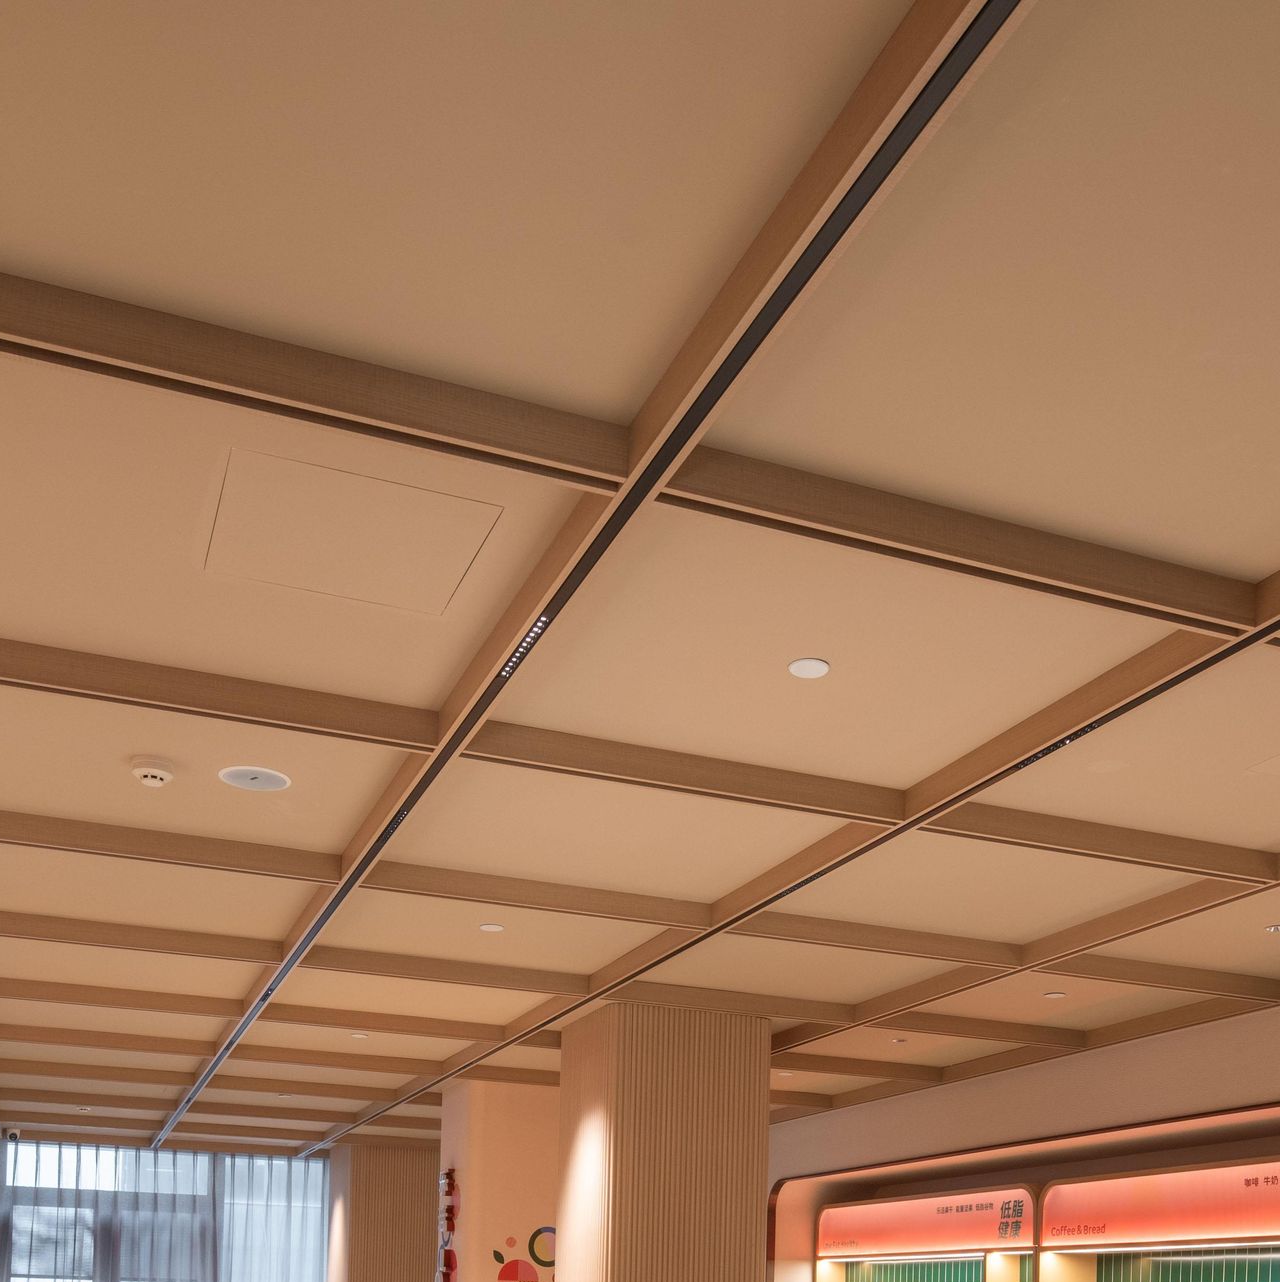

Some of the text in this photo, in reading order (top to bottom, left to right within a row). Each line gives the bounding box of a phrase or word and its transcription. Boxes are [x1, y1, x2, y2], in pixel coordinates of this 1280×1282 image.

[1263, 1175, 1278, 1186] 牛奶
[1001, 1200, 1024, 1219] 低脂
[998, 1221, 1022, 1239] 健康
